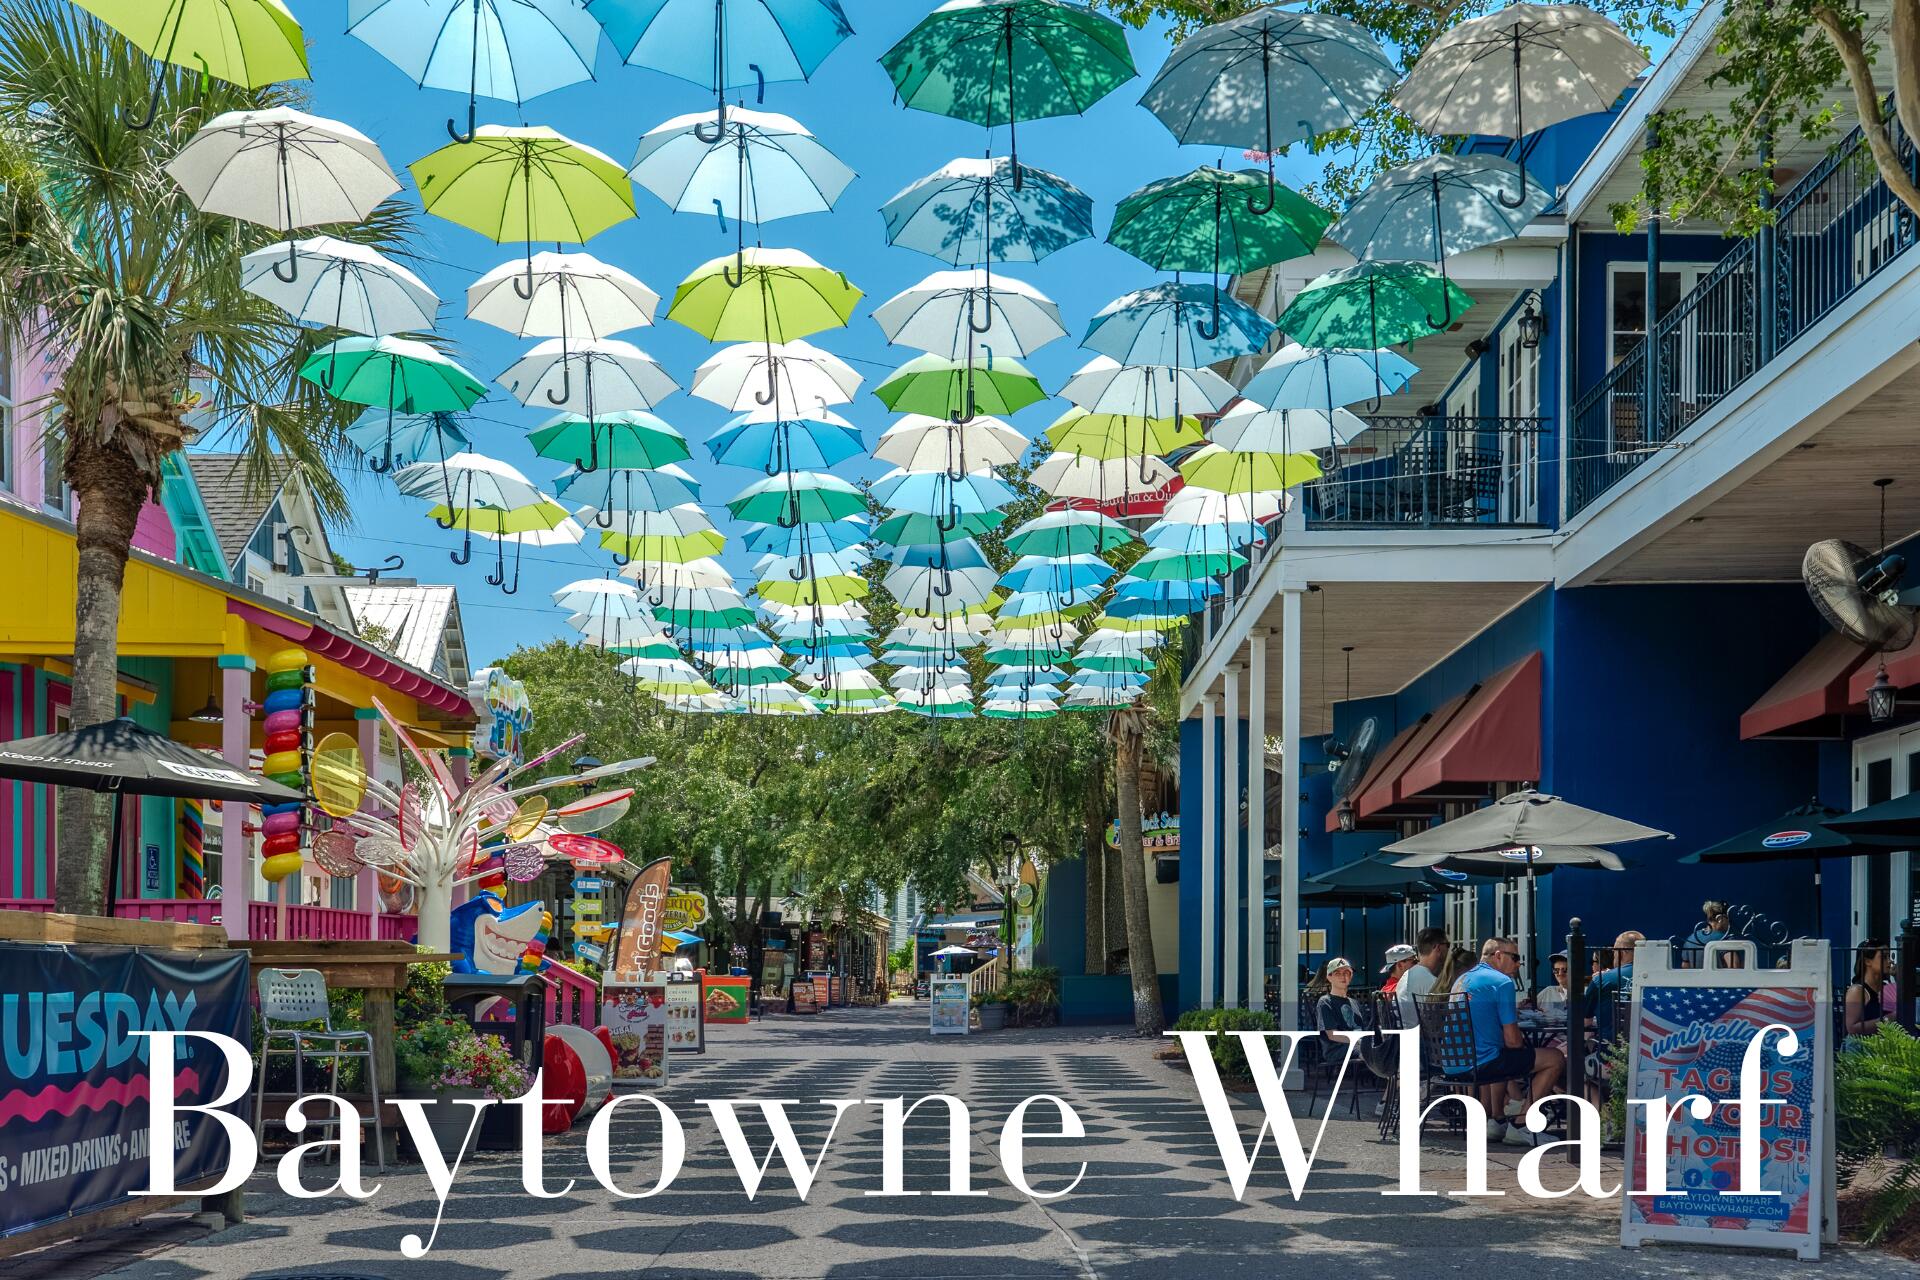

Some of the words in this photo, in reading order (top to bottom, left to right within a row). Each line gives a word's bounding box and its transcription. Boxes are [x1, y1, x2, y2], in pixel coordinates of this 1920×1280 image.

[637, 883, 659, 952] Goods
[1658, 1067, 1731, 1092] TAG
[20, 1144, 70, 1186] MIXED
[71, 1133, 121, 1175] DRINKS
[1659, 1200, 1784, 1216] BAYTOWNEWHARF.COM
